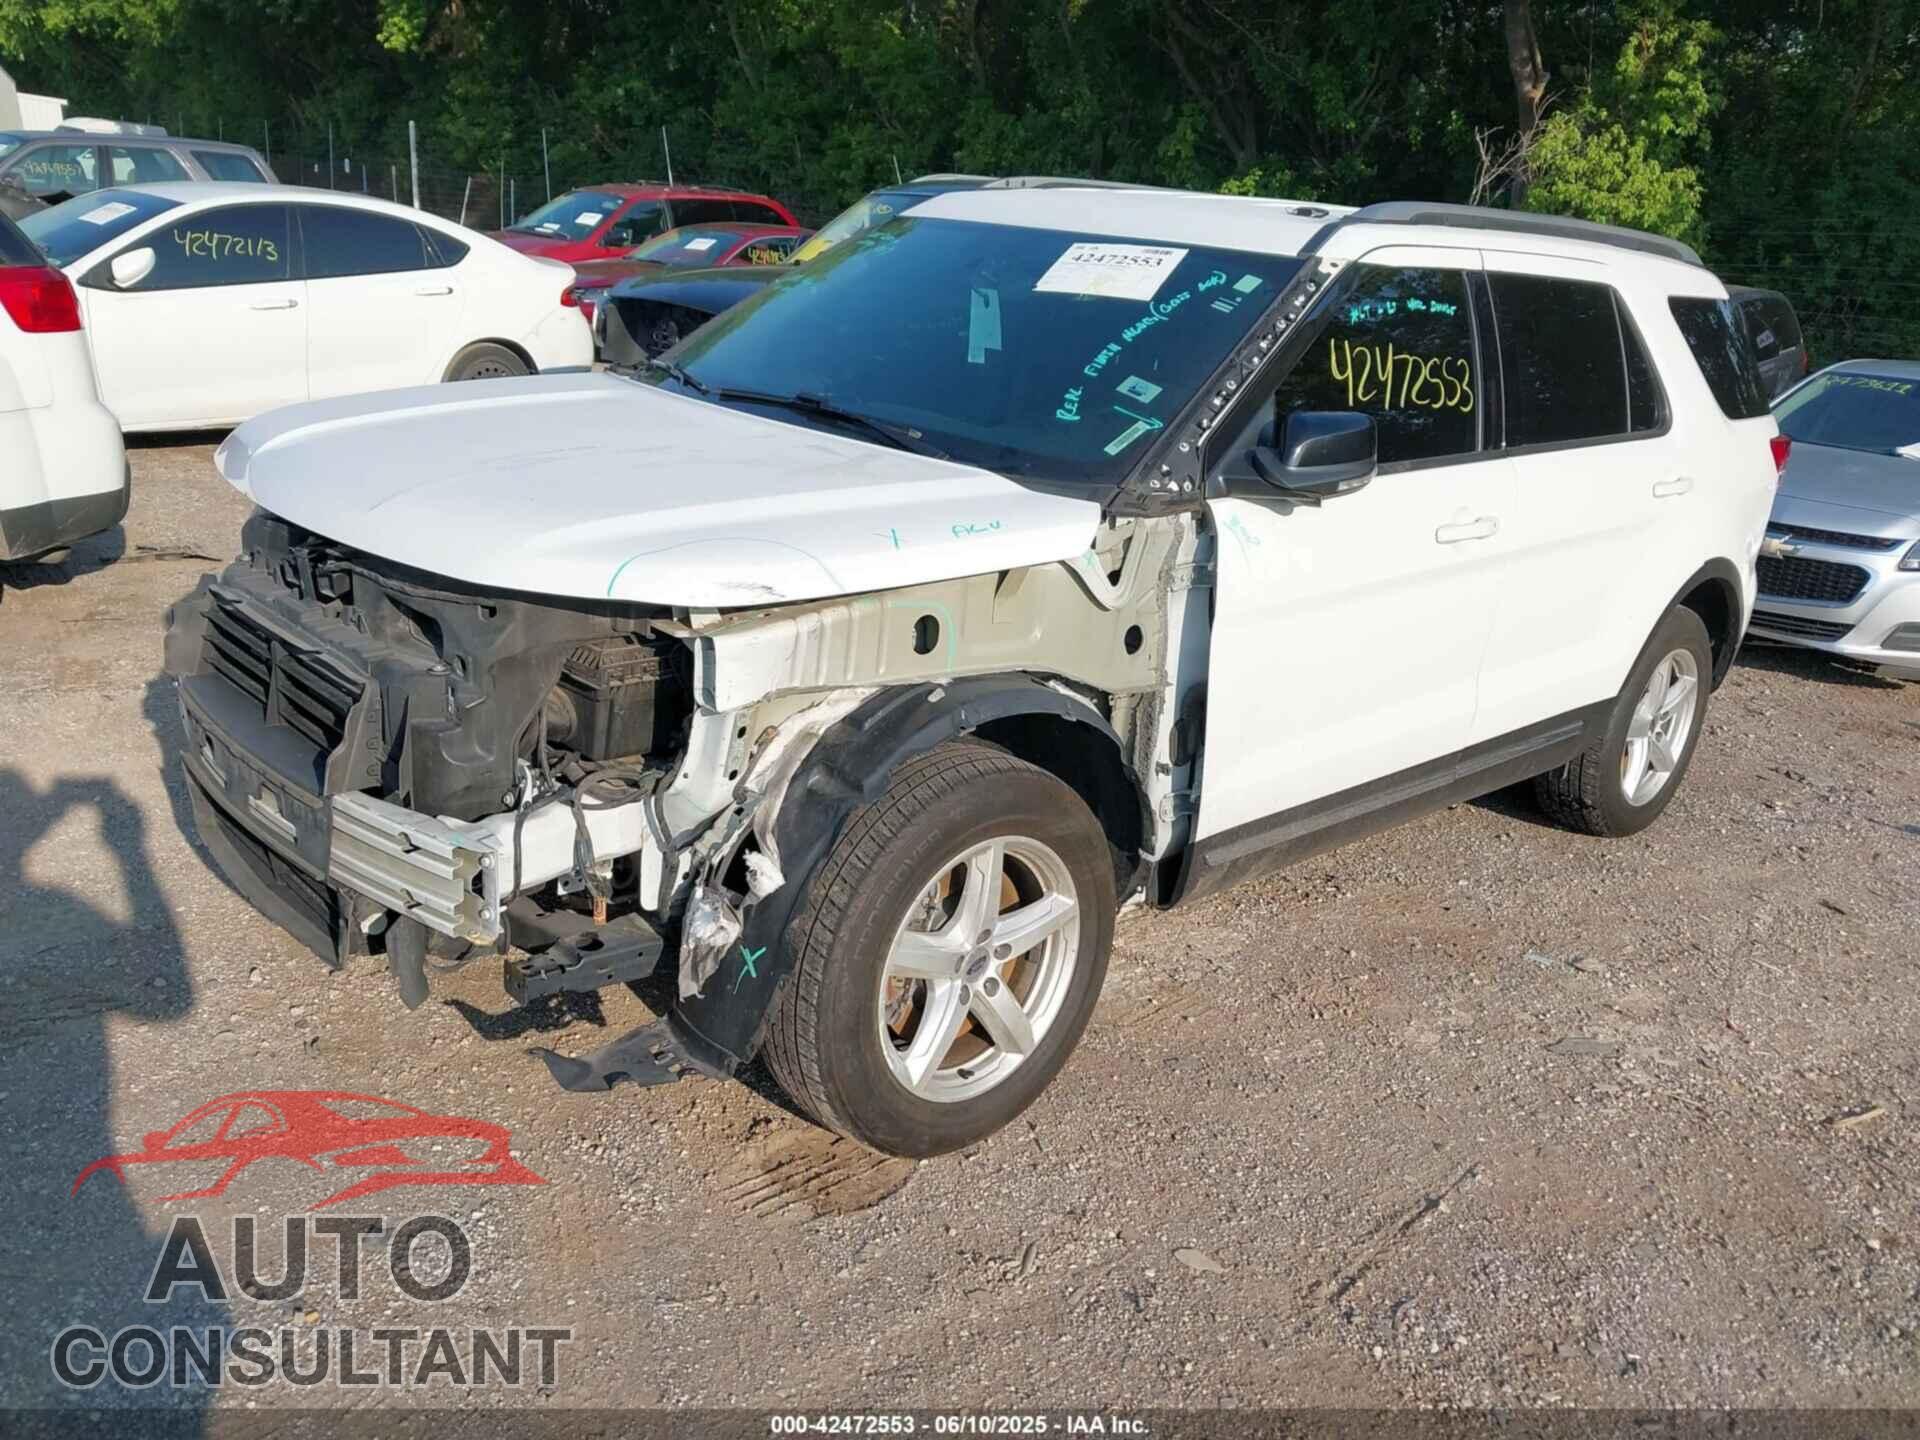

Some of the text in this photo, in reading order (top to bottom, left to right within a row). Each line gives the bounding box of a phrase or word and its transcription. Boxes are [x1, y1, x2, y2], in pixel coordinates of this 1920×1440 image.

[174, 229, 278, 260] 42472113
[1072, 253, 1163, 267] 42472553
[1331, 338, 1474, 412] 42472553
